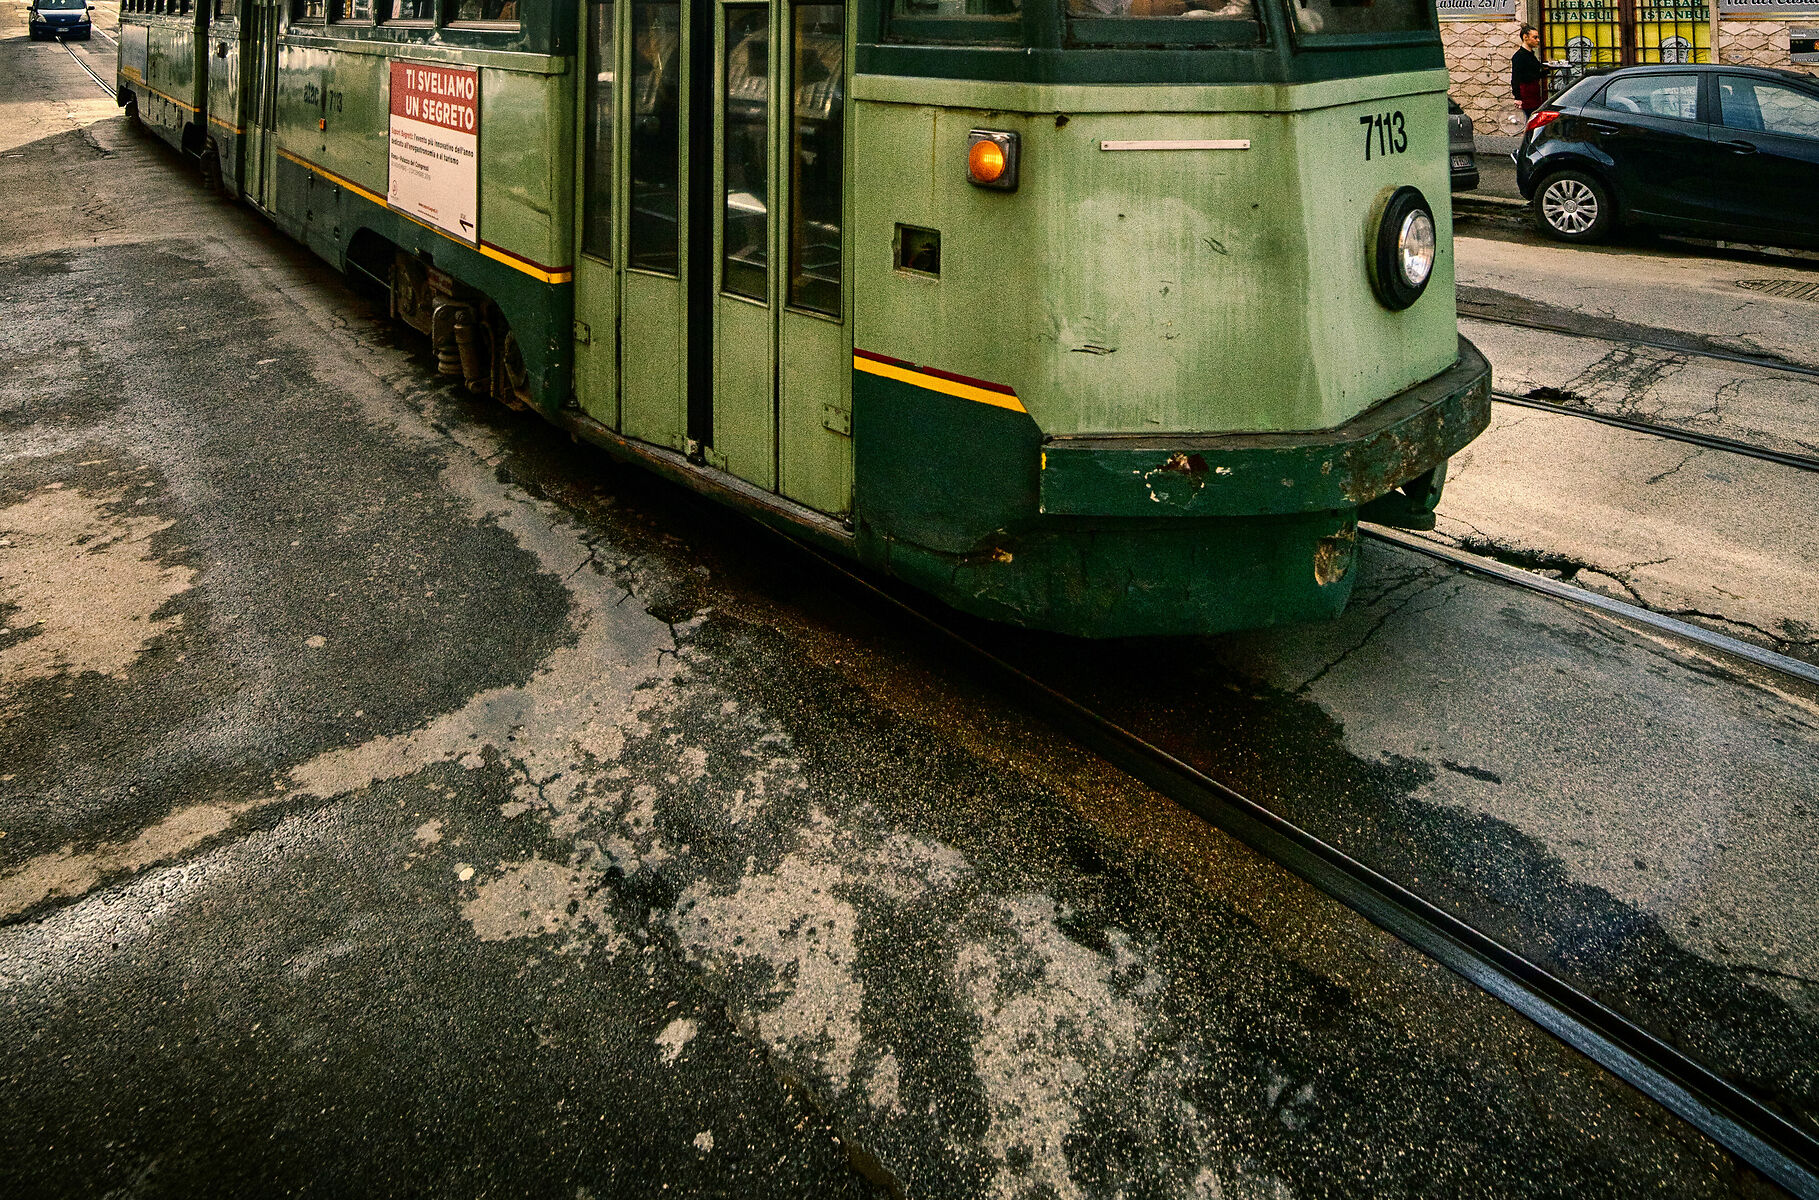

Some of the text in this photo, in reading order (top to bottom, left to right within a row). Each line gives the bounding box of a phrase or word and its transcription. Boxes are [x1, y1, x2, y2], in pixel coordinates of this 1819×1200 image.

[406, 69, 474, 101] TI SVELIAMO
[405, 95, 474, 130] UN SEGRETO
[1360, 110, 1408, 161] 7113
